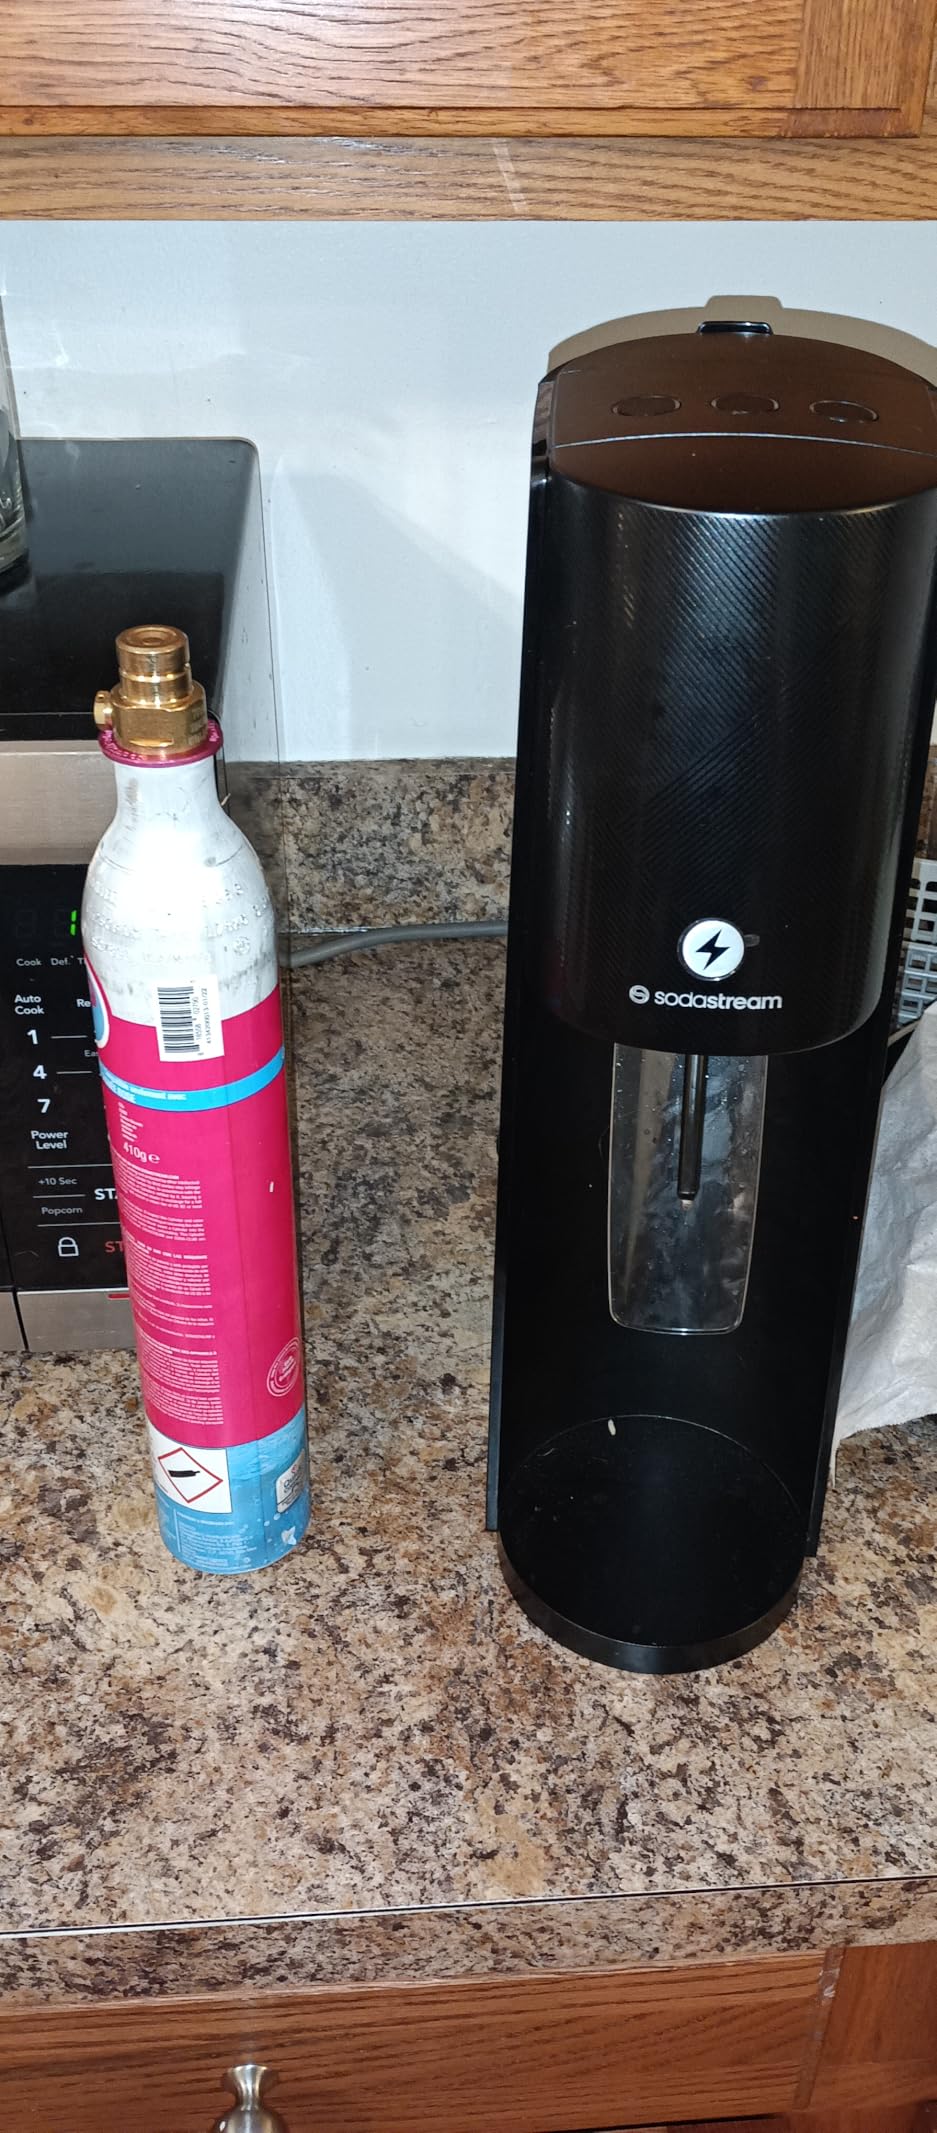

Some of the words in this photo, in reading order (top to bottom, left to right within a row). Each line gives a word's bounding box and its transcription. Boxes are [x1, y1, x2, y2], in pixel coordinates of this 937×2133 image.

[16, 958, 42, 967] Cook
[15, 994, 42, 1004] Auto
[654, 991, 783, 1010] sodastream
[15, 1005, 45, 1015] Cook
[27, 1029, 39, 1045] 1
[33, 1064, 48, 1080] 4
[37, 1098, 51, 1114] 7
[31, 1130, 68, 1140] Power
[35, 1139, 68, 1150] Level
[38, 1177, 57, 1186] +10
[59, 1176, 77, 1186] Sec
[41, 1206, 83, 1217] Popcorn
